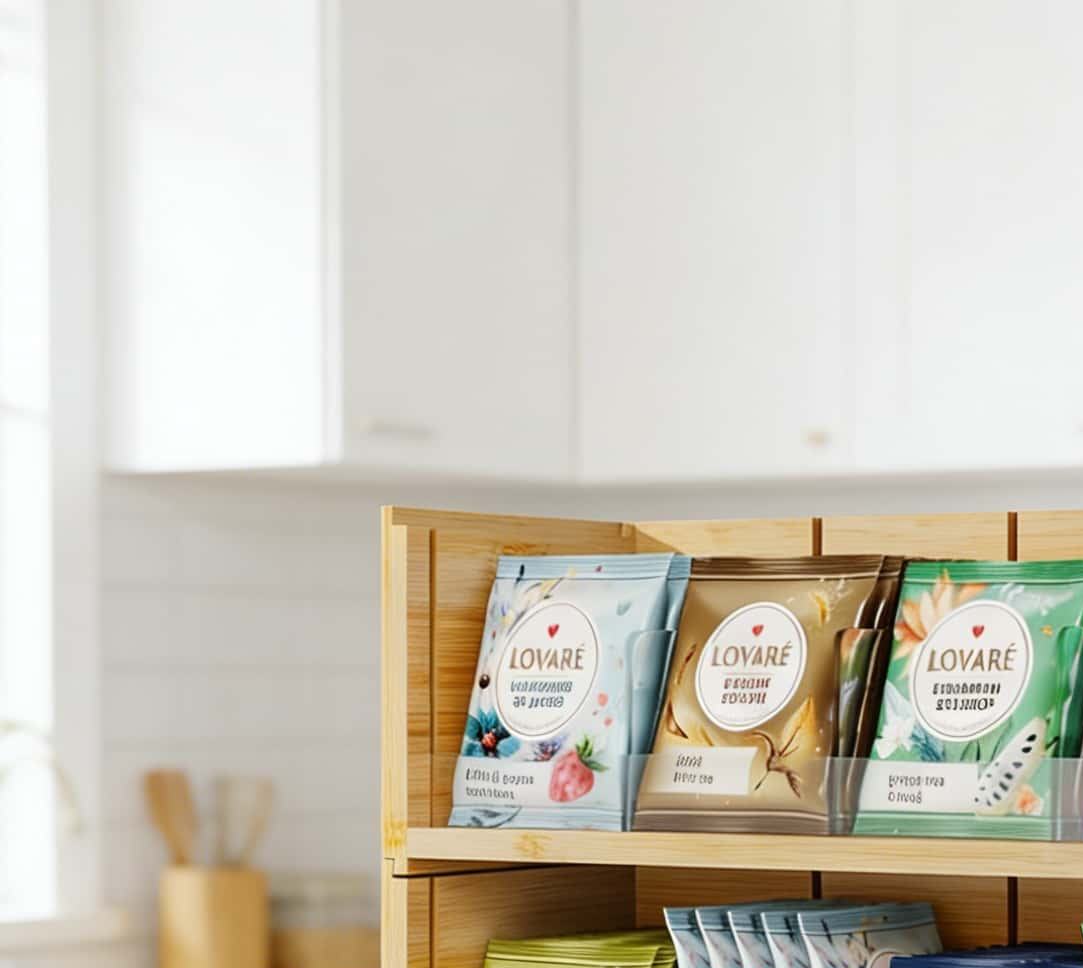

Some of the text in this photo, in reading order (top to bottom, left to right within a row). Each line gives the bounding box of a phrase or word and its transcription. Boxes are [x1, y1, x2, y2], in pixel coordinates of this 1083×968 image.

[509, 643, 585, 671] LOVARÉ
[711, 641, 793, 669] LOVARÉ
[927, 642, 1017, 673] LOVARÉ
